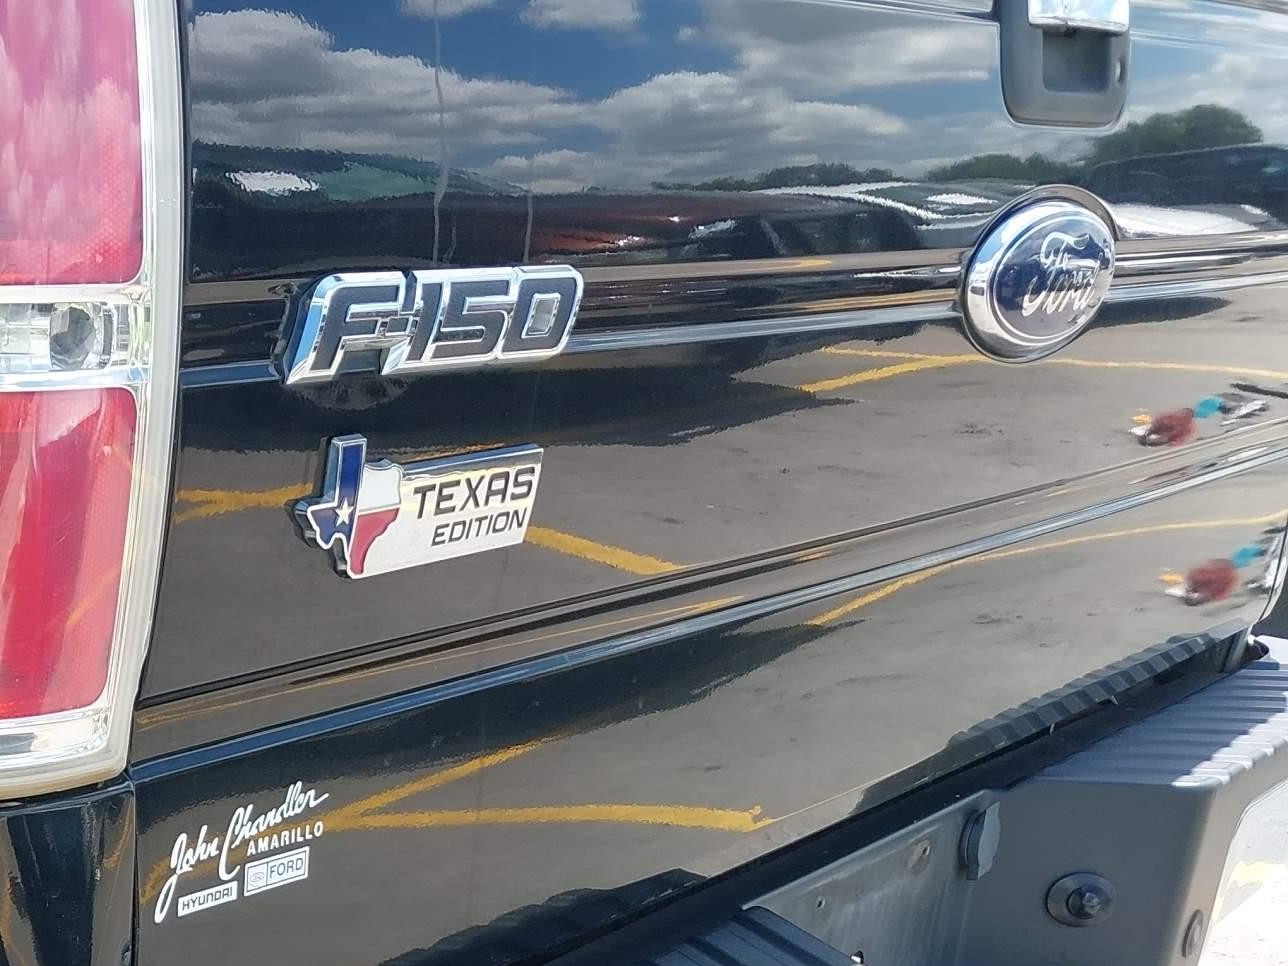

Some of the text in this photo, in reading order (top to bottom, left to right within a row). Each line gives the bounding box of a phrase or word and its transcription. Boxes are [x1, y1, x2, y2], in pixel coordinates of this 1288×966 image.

[1021, 231, 1102, 318] Ford
[289, 265, 585, 383] F-150
[412, 466, 535, 521] TEXAS
[430, 507, 529, 547] EDITION
[154, 780, 330, 924] John Chandler
[246, 820, 324, 857] AMARILLO
[269, 857, 304, 879] FORD
[181, 886, 233, 911] HYUNDAI
